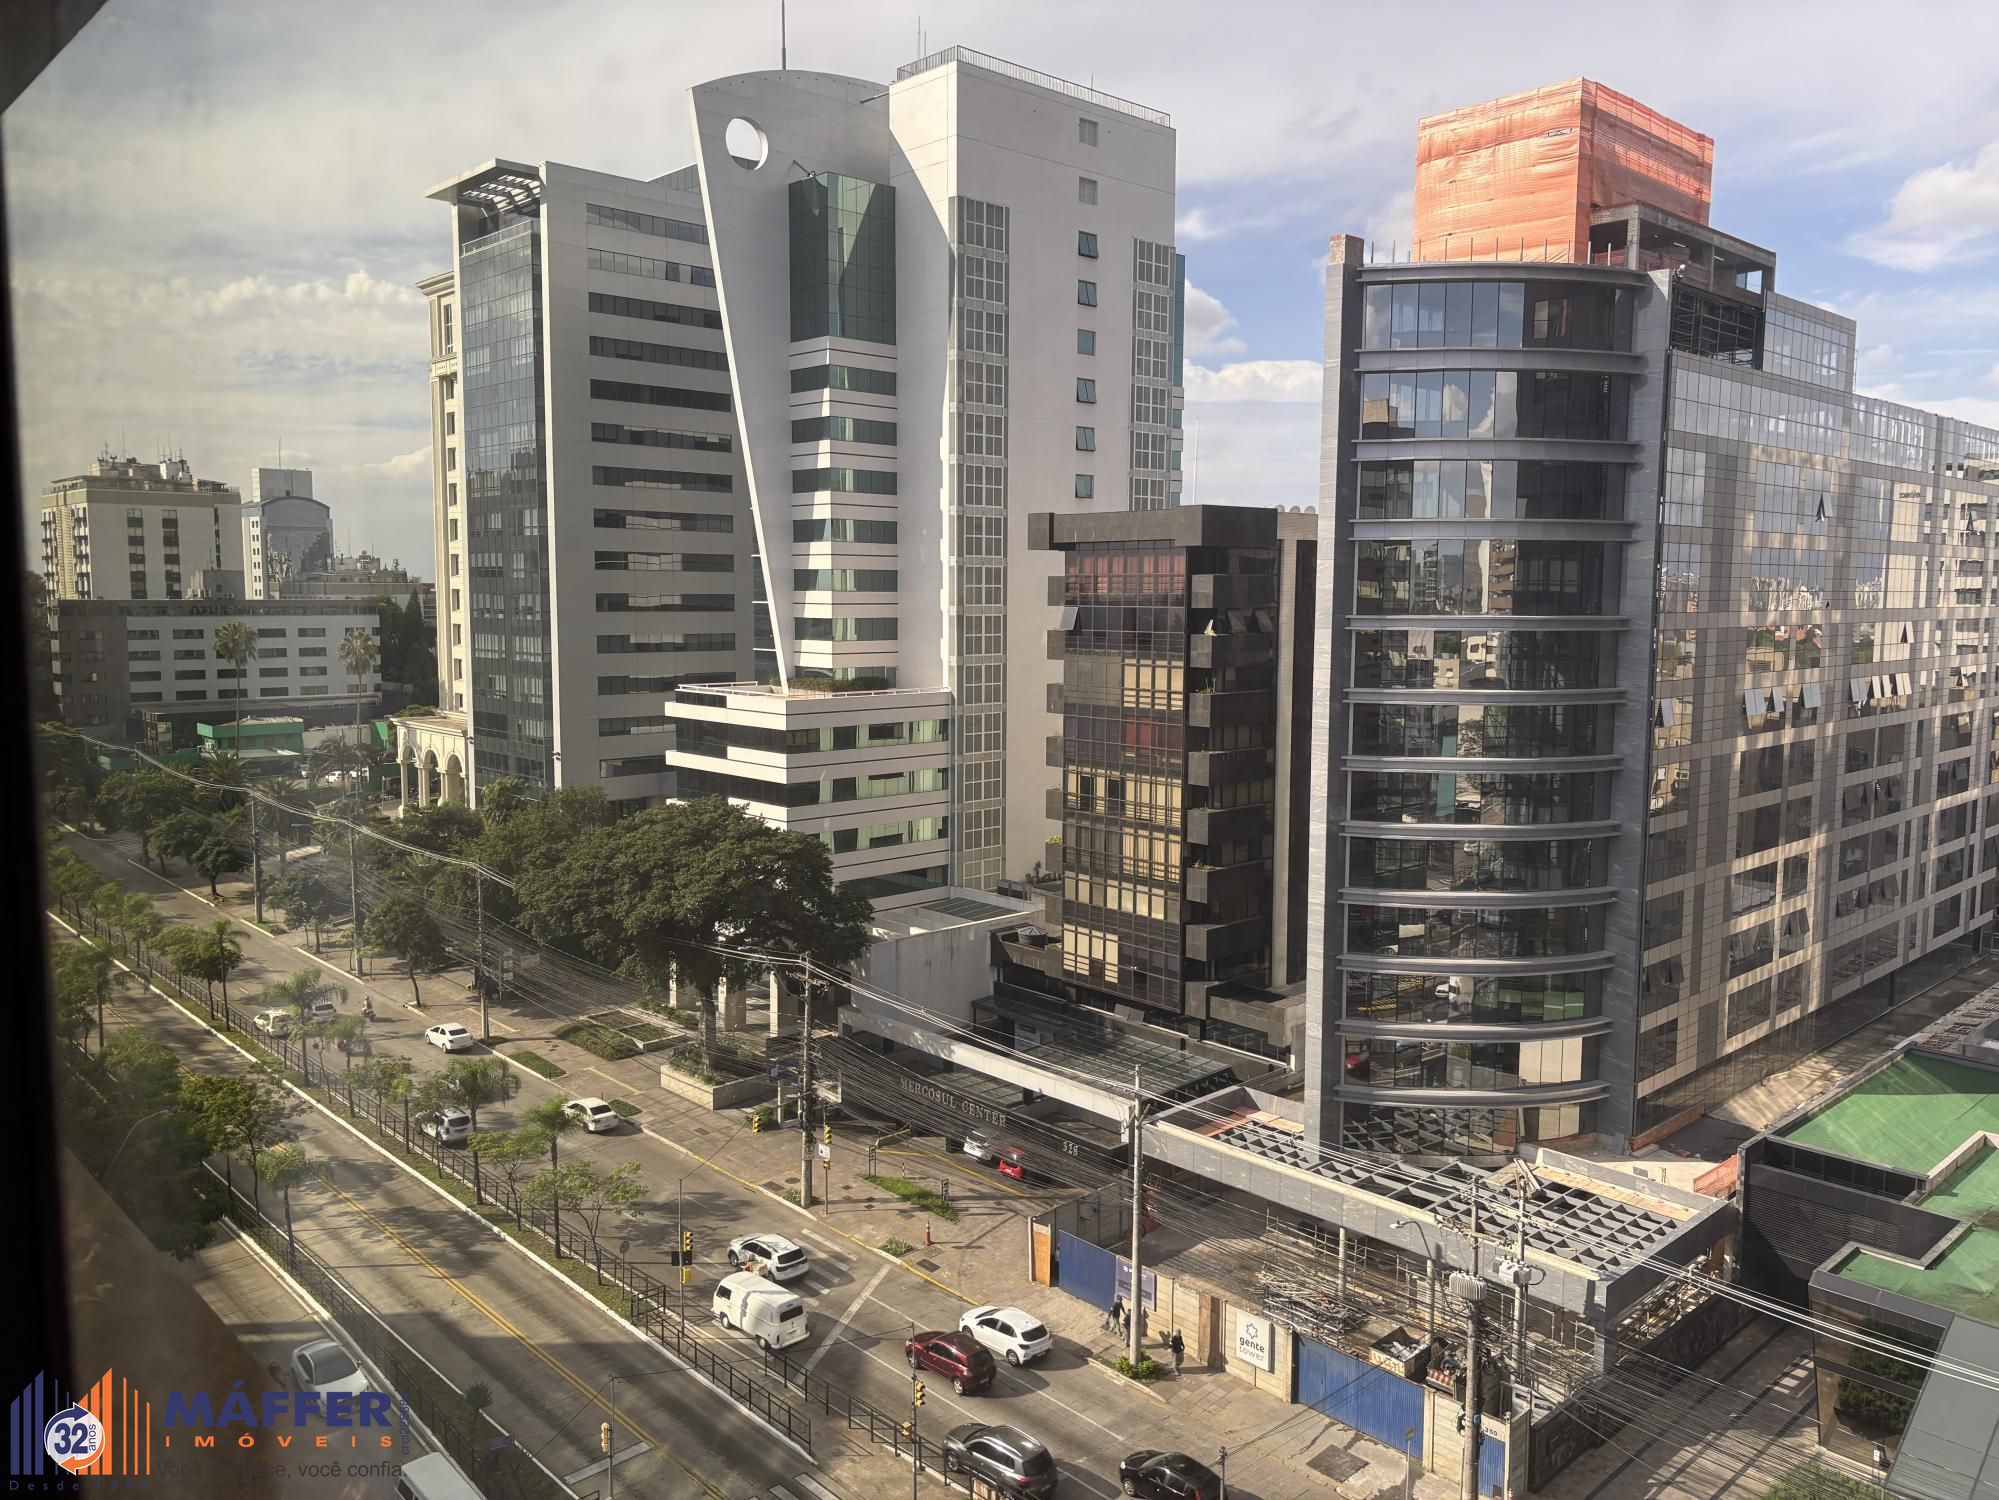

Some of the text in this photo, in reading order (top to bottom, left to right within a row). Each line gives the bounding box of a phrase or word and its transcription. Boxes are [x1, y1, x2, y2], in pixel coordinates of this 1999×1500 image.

[899, 1077, 1007, 1128] MERCOSUL CENTER
[1239, 1336, 1265, 1353] gente
[1239, 1345, 1265, 1361] tower
